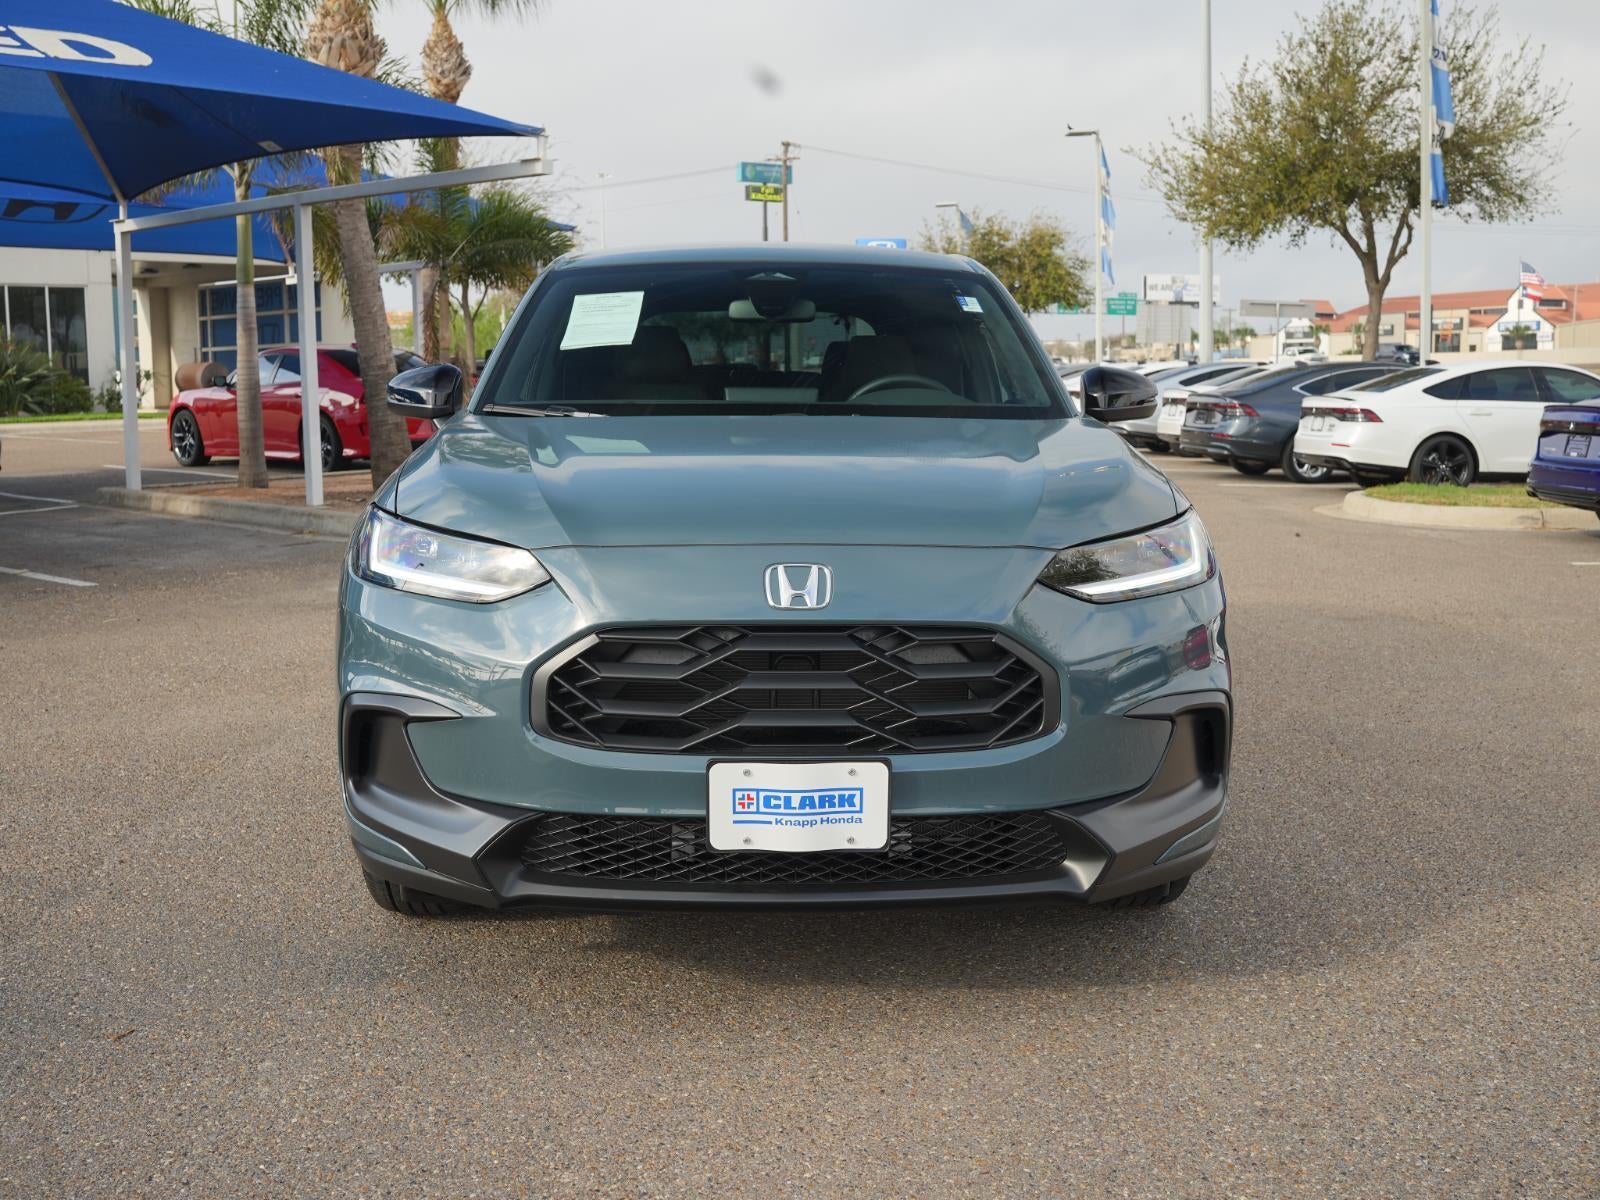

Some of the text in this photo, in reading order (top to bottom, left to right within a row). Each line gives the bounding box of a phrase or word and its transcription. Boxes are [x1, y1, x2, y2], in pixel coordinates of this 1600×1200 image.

[763, 793, 857, 811] CLARK
[775, 815, 863, 828] Knapp Honda
